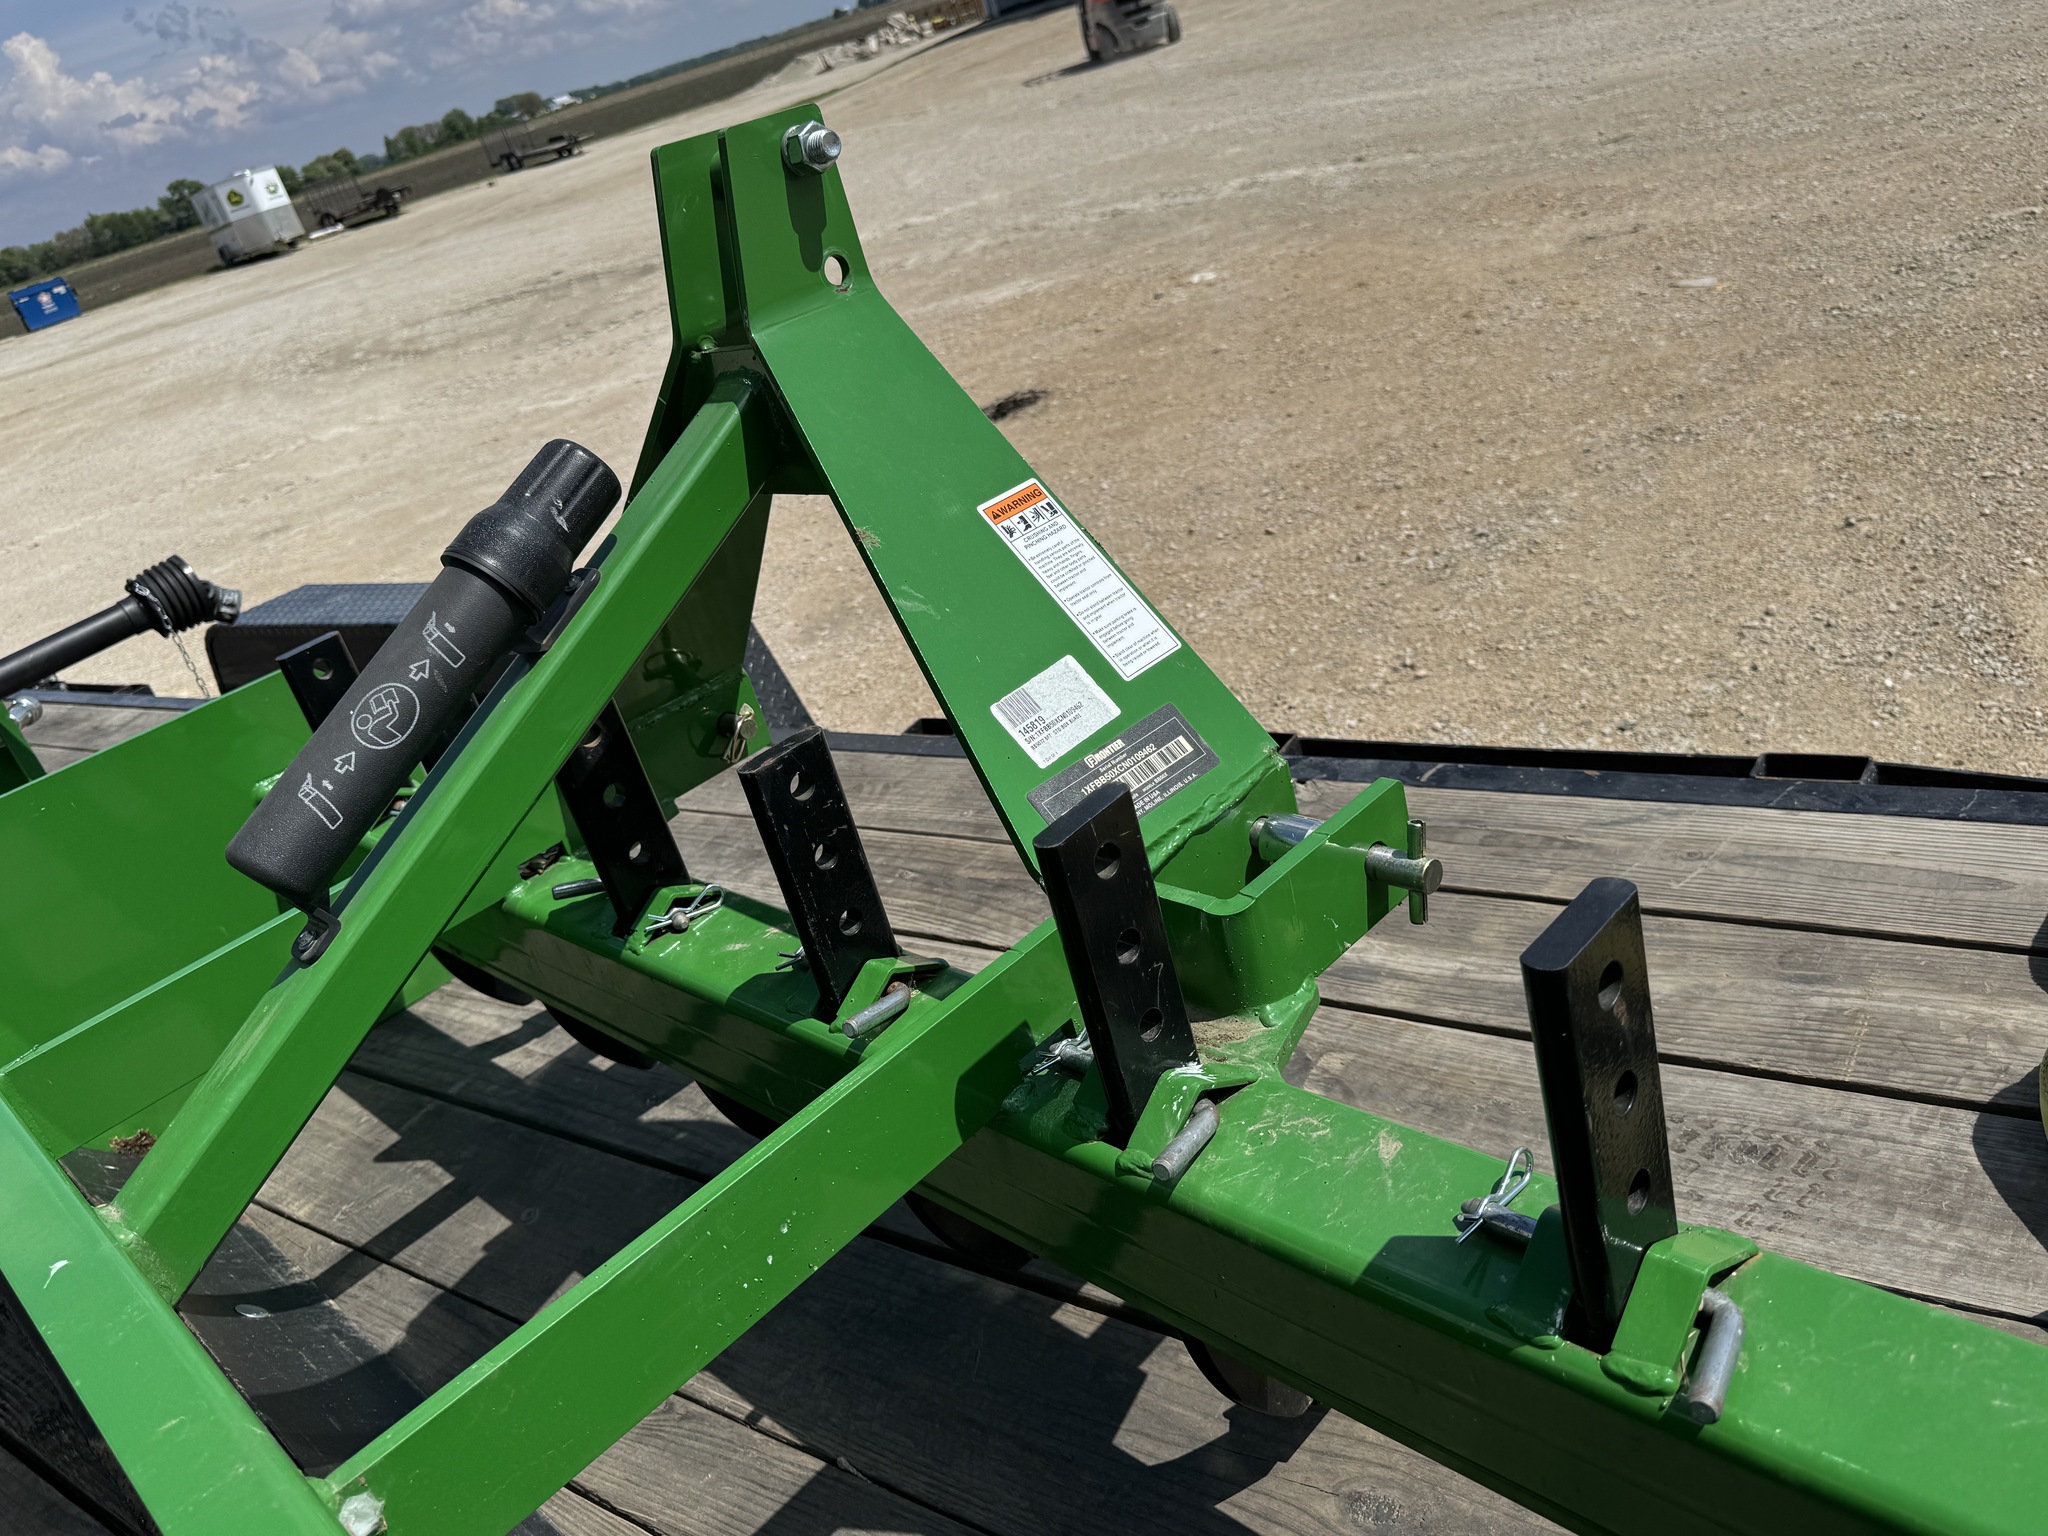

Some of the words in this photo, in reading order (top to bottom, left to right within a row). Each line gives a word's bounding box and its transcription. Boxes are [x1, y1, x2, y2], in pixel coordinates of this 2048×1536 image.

[995, 487, 1043, 516] WARNING
[1021, 525, 1049, 543] CRUSHING
[1046, 520, 1059, 529] AND
[1023, 534, 1048, 550] PINCHING
[1045, 523, 1067, 537] HAZARD
[1016, 714, 1047, 738] 145819
[1082, 736, 1127, 768] FRONTIER
[1098, 761, 1113, 773] Serial
[1109, 751, 1128, 765] Number
[1078, 742, 1159, 796] 1XFBB50XCN0109462
[1131, 798, 1146, 810] ADE
[1142, 795, 1151, 803] IN
[1147, 788, 1161, 799] USA
[1142, 794, 1165, 811] MOLINE,
[1161, 780, 1185, 798] ILLINOIS,
[1181, 770, 1199, 784] U.S.A.
